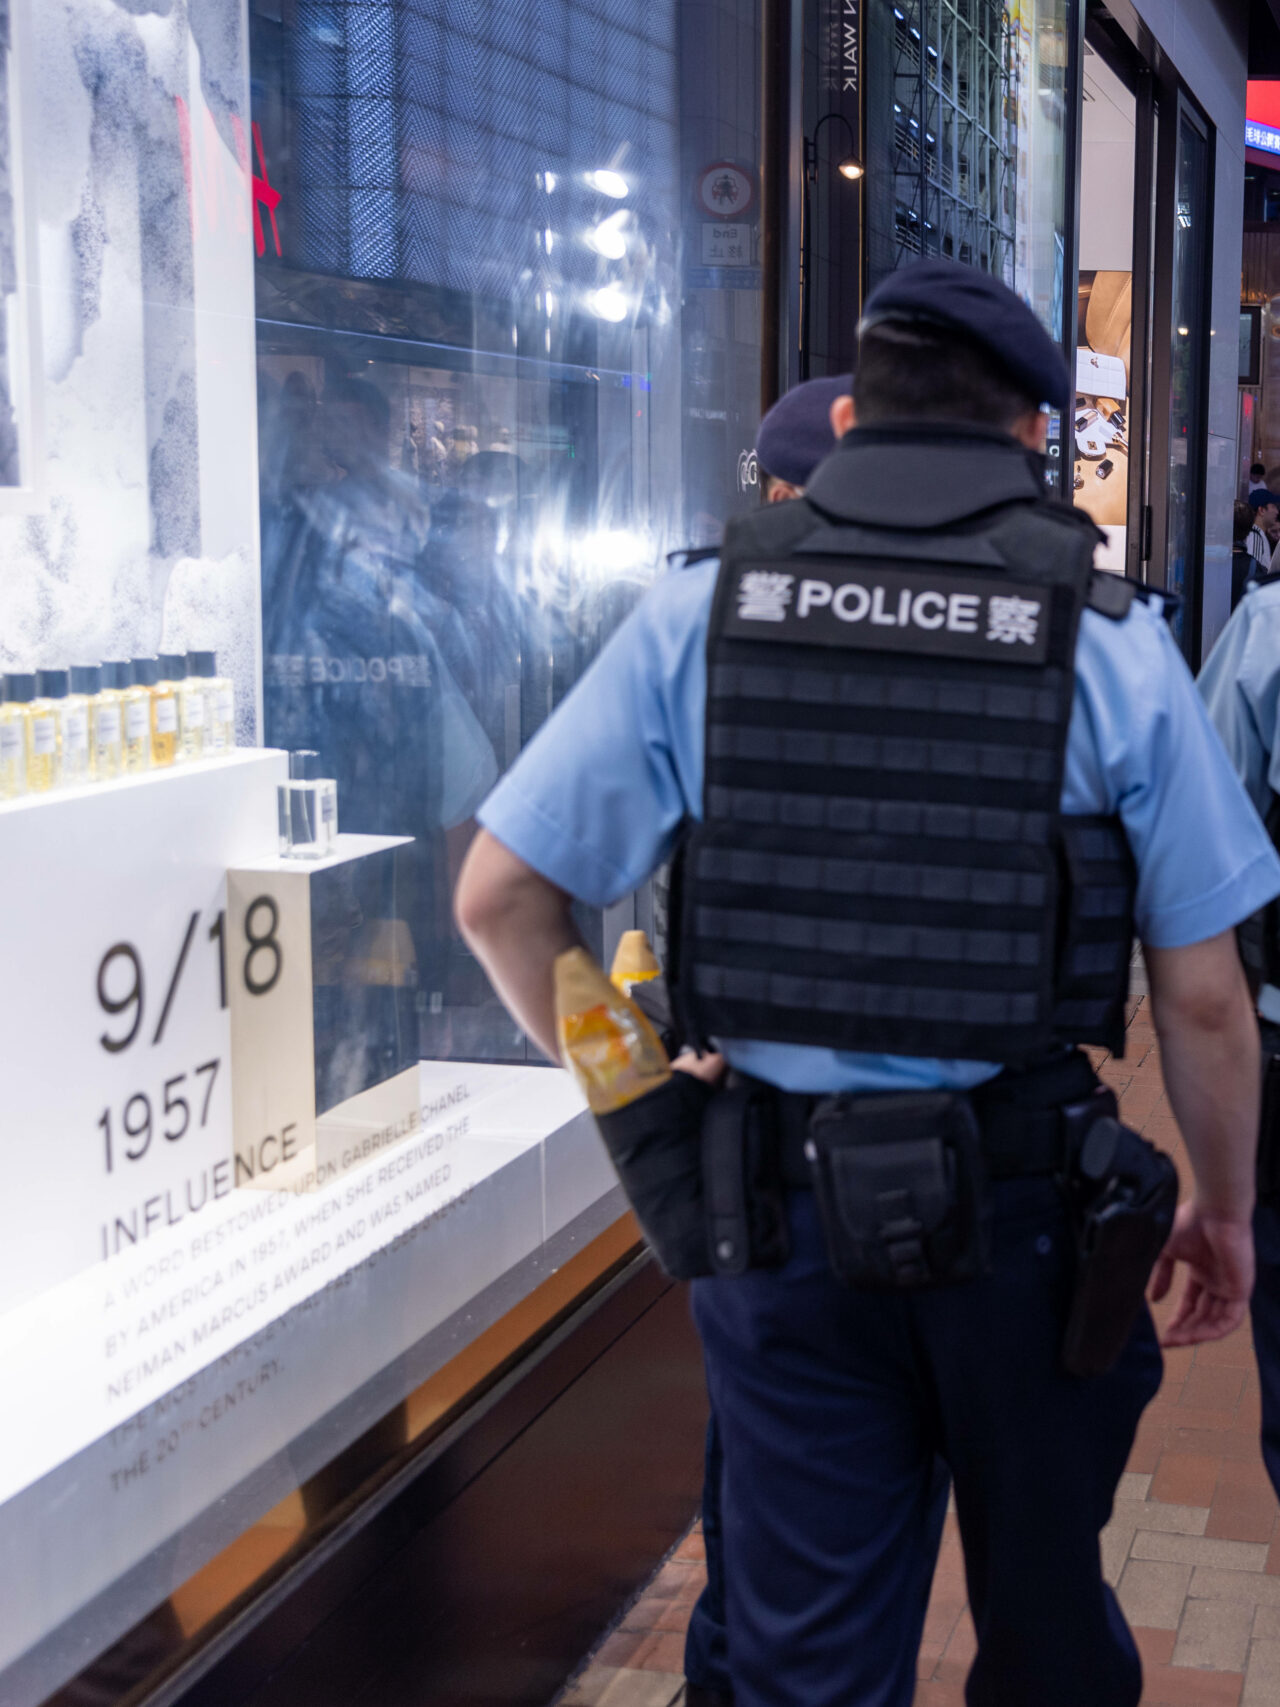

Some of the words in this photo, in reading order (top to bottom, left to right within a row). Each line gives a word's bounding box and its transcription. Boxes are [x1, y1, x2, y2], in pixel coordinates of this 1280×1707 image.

[736, 570, 796, 623] 警
[796, 579, 982, 634] POLICE
[985, 595, 1042, 646] 察
[96, 893, 283, 1055] 9/18
[98, 1056, 221, 1174] 1957
[101, 1121, 298, 1262] INFLUENCE
[103, 1326, 130, 1359] BY
[137, 1269, 225, 1338] AMERICA
[228, 1254, 248, 1281] IN
[294, 1197, 343, 1238] WHEN
[345, 1174, 375, 1207] SHE
[377, 1132, 444, 1187] RECEIVED
[446, 1114, 471, 1144] THE
[121, 1247, 186, 1301] WORD
[190, 1187, 290, 1262] BESTOWED
[293, 1160, 337, 1198] UPON
[341, 1110, 419, 1170] GABRIELLE
[420, 1083, 471, 1123] CHANEL
[106, 1338, 188, 1405] NEIMAN
[192, 1281, 269, 1348] MARCUS
[272, 1241, 333, 1295] AWARD
[335, 1217, 367, 1252] AND
[369, 1193, 403, 1230] WAS
[405, 1163, 452, 1204] NAMED
[110, 1449, 150, 1494] THE
